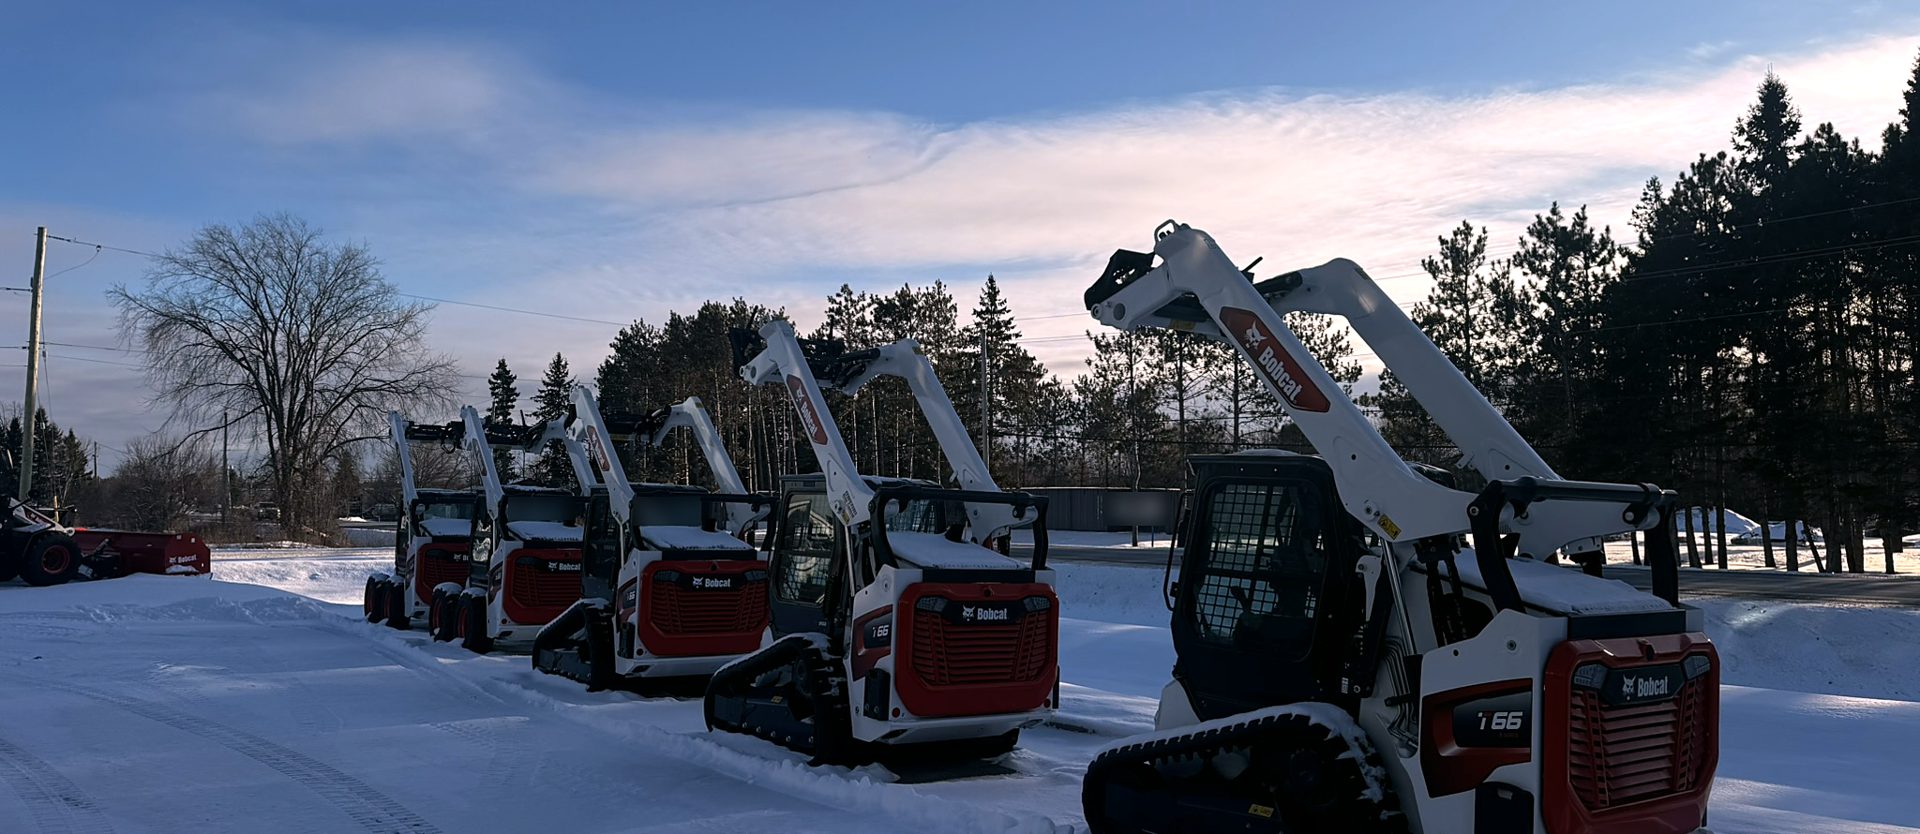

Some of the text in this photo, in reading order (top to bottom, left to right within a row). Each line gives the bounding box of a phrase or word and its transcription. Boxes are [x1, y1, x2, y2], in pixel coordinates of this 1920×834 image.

[1258, 346, 1303, 402] Bobcat
[704, 578, 731, 588] Bobcat
[977, 607, 1008, 621] Bobcat
[1637, 676, 1669, 698] Bobcat
